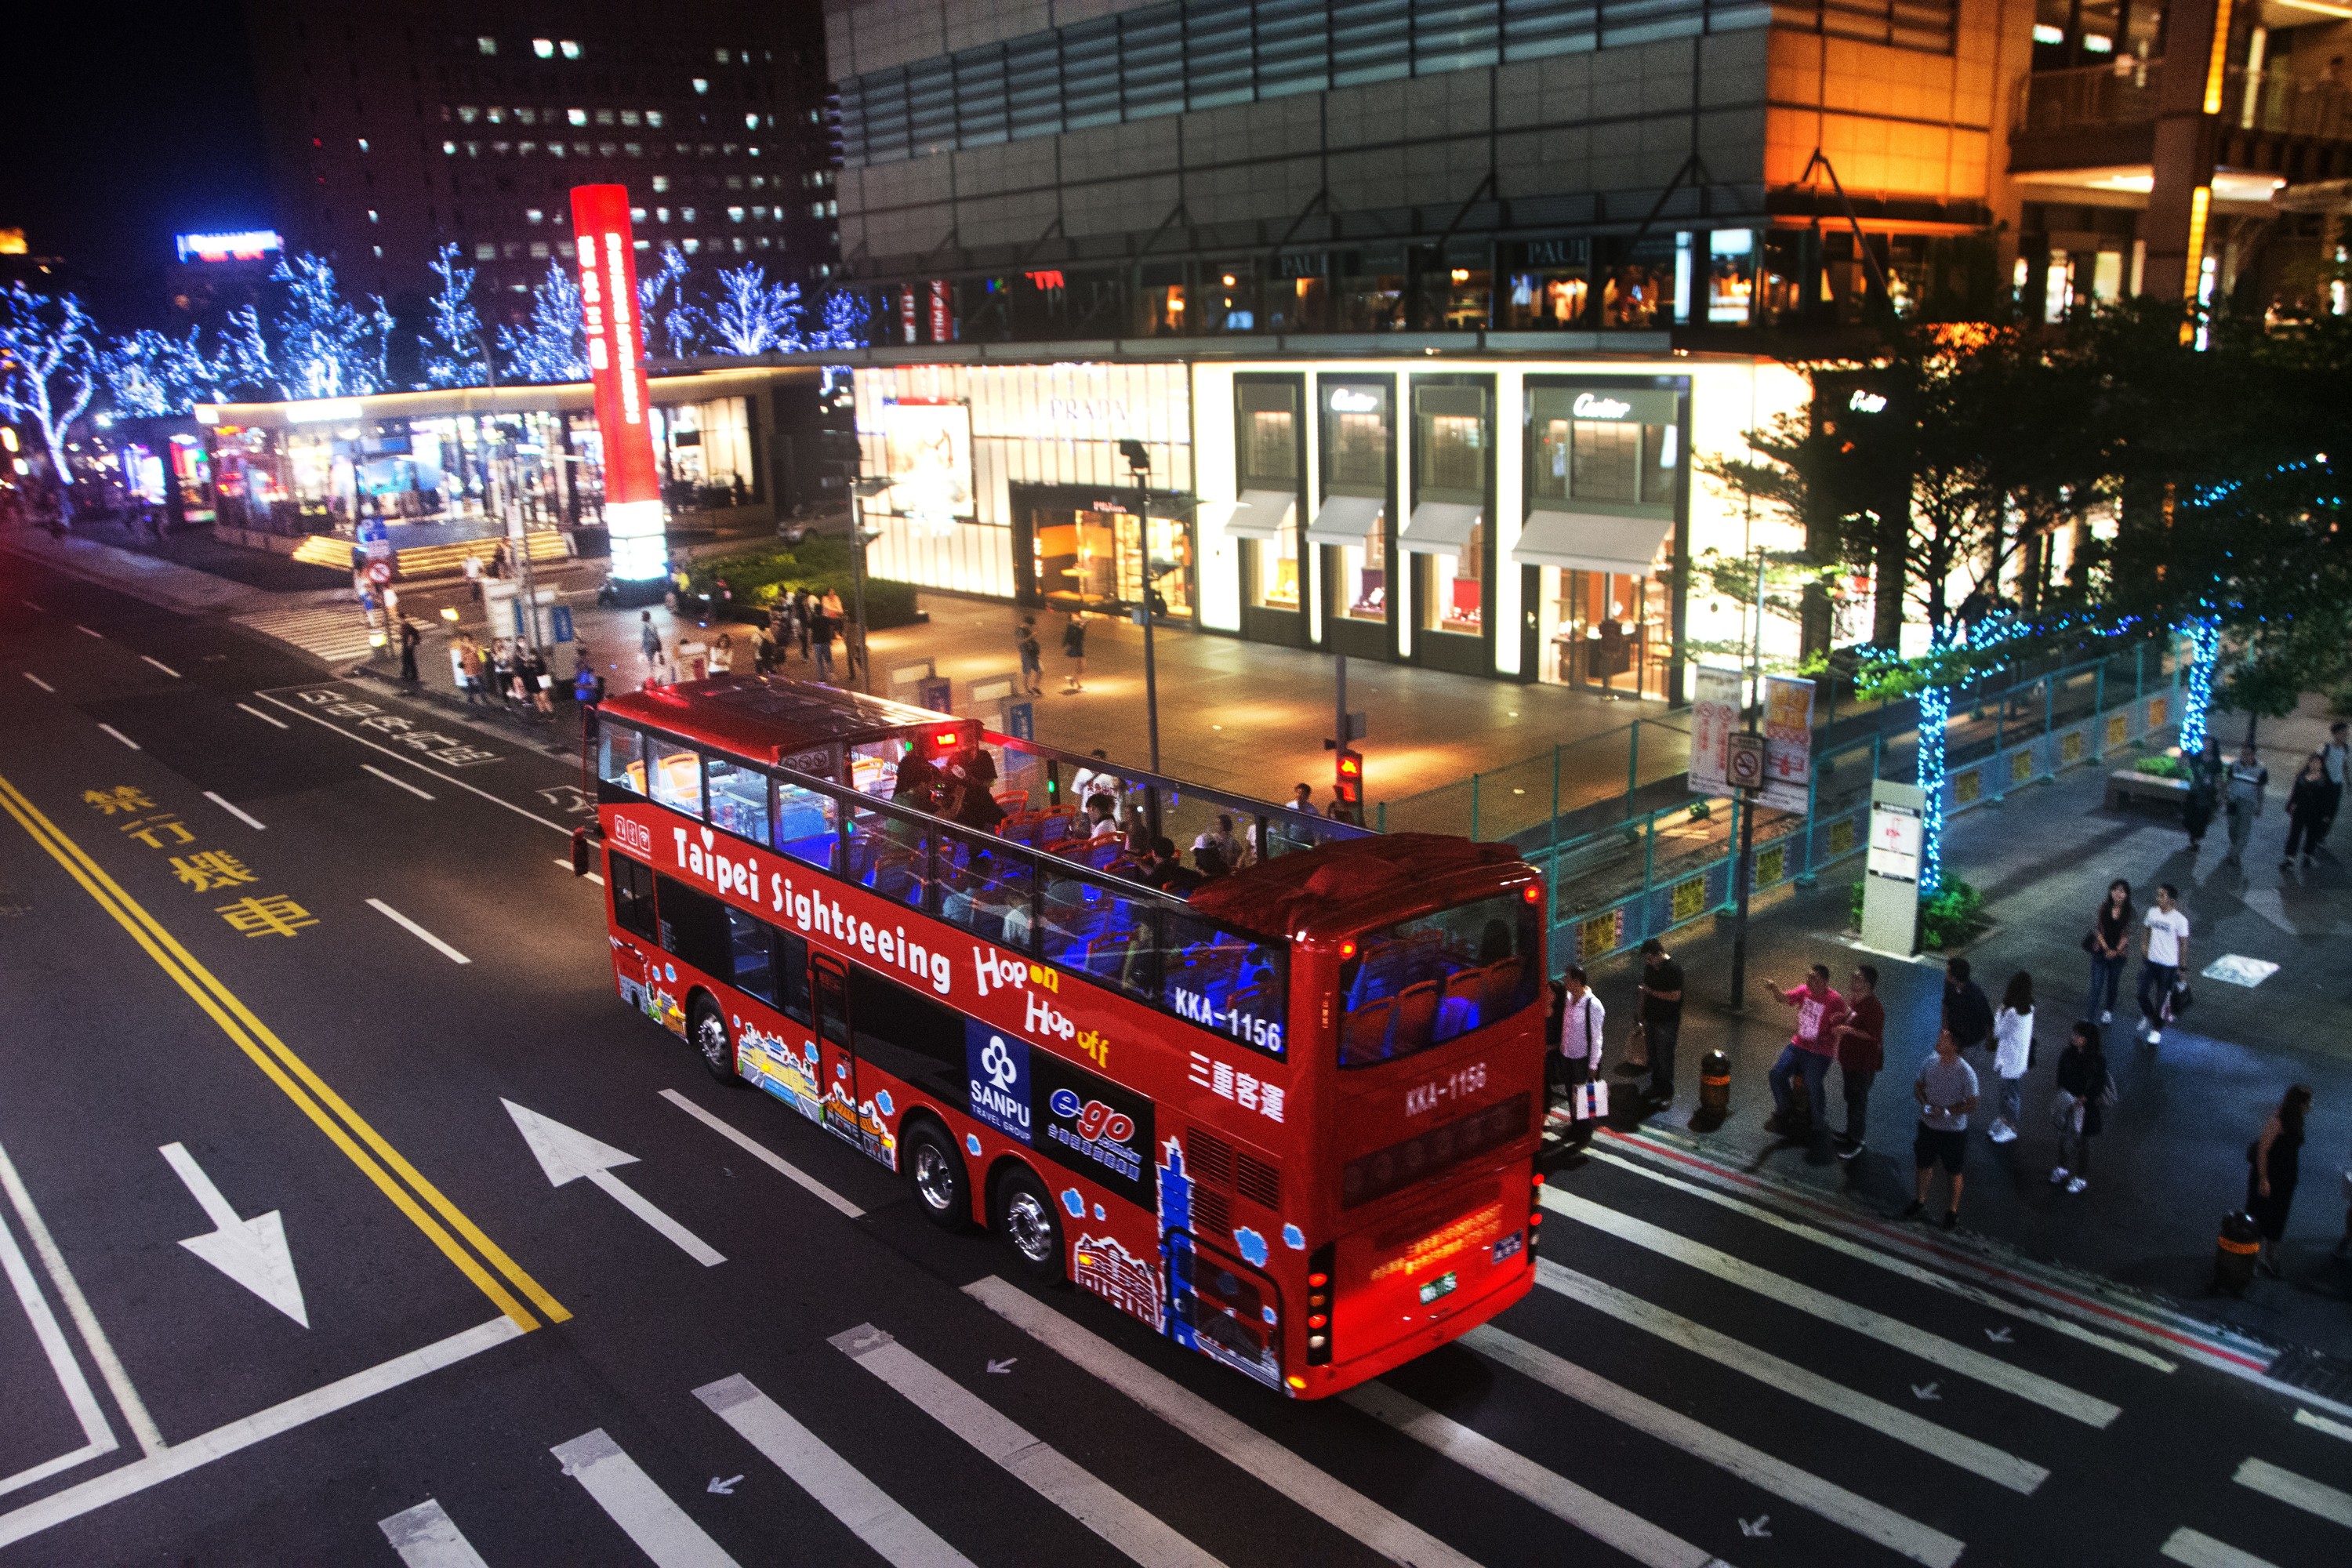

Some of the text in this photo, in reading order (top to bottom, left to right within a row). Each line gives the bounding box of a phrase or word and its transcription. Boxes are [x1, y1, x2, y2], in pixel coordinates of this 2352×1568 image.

[81, 785, 320, 938] 禁行機車
[673, 826, 951, 995] Taipei Sightseeing
[973, 946, 1058, 996] Hop on
[1024, 990, 1109, 1069] Hop off
[1176, 986, 1282, 1051] KKA-1156
[971, 1080, 1030, 1127] SANPU
[1189, 1051, 1286, 1123] 三重客運
[1406, 1062, 1486, 1118] KKA-1156
[971, 1104, 1032, 1142] TRAVEL GROUP
